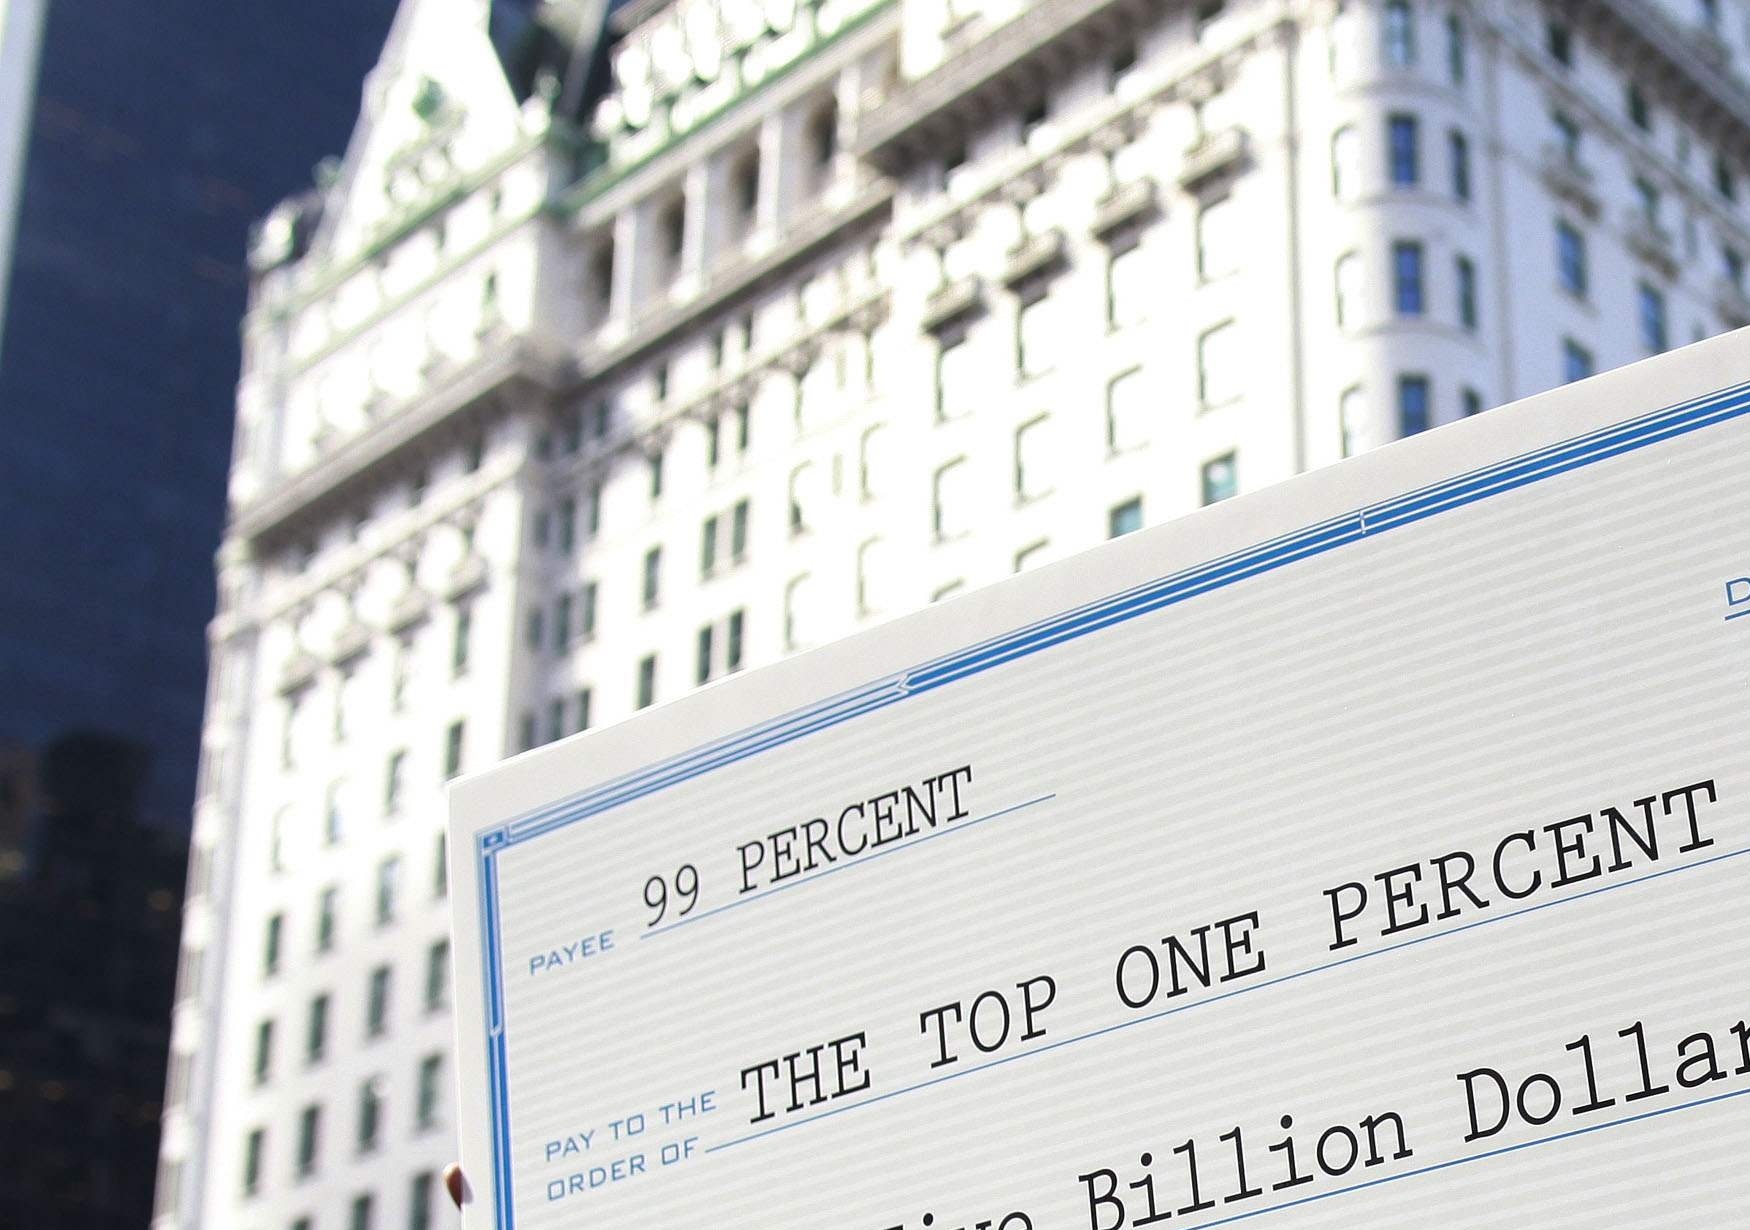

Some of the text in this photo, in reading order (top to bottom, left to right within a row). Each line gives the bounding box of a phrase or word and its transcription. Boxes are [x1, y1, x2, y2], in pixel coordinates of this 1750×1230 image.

[528, 765, 972, 977] PAYEE 99 PERCENT
[739, 779, 1719, 1125] THE TOP ONE PERCENT
[544, 1090, 718, 1164] PAY TO THE
[547, 1136, 700, 1203] ORDER OF
